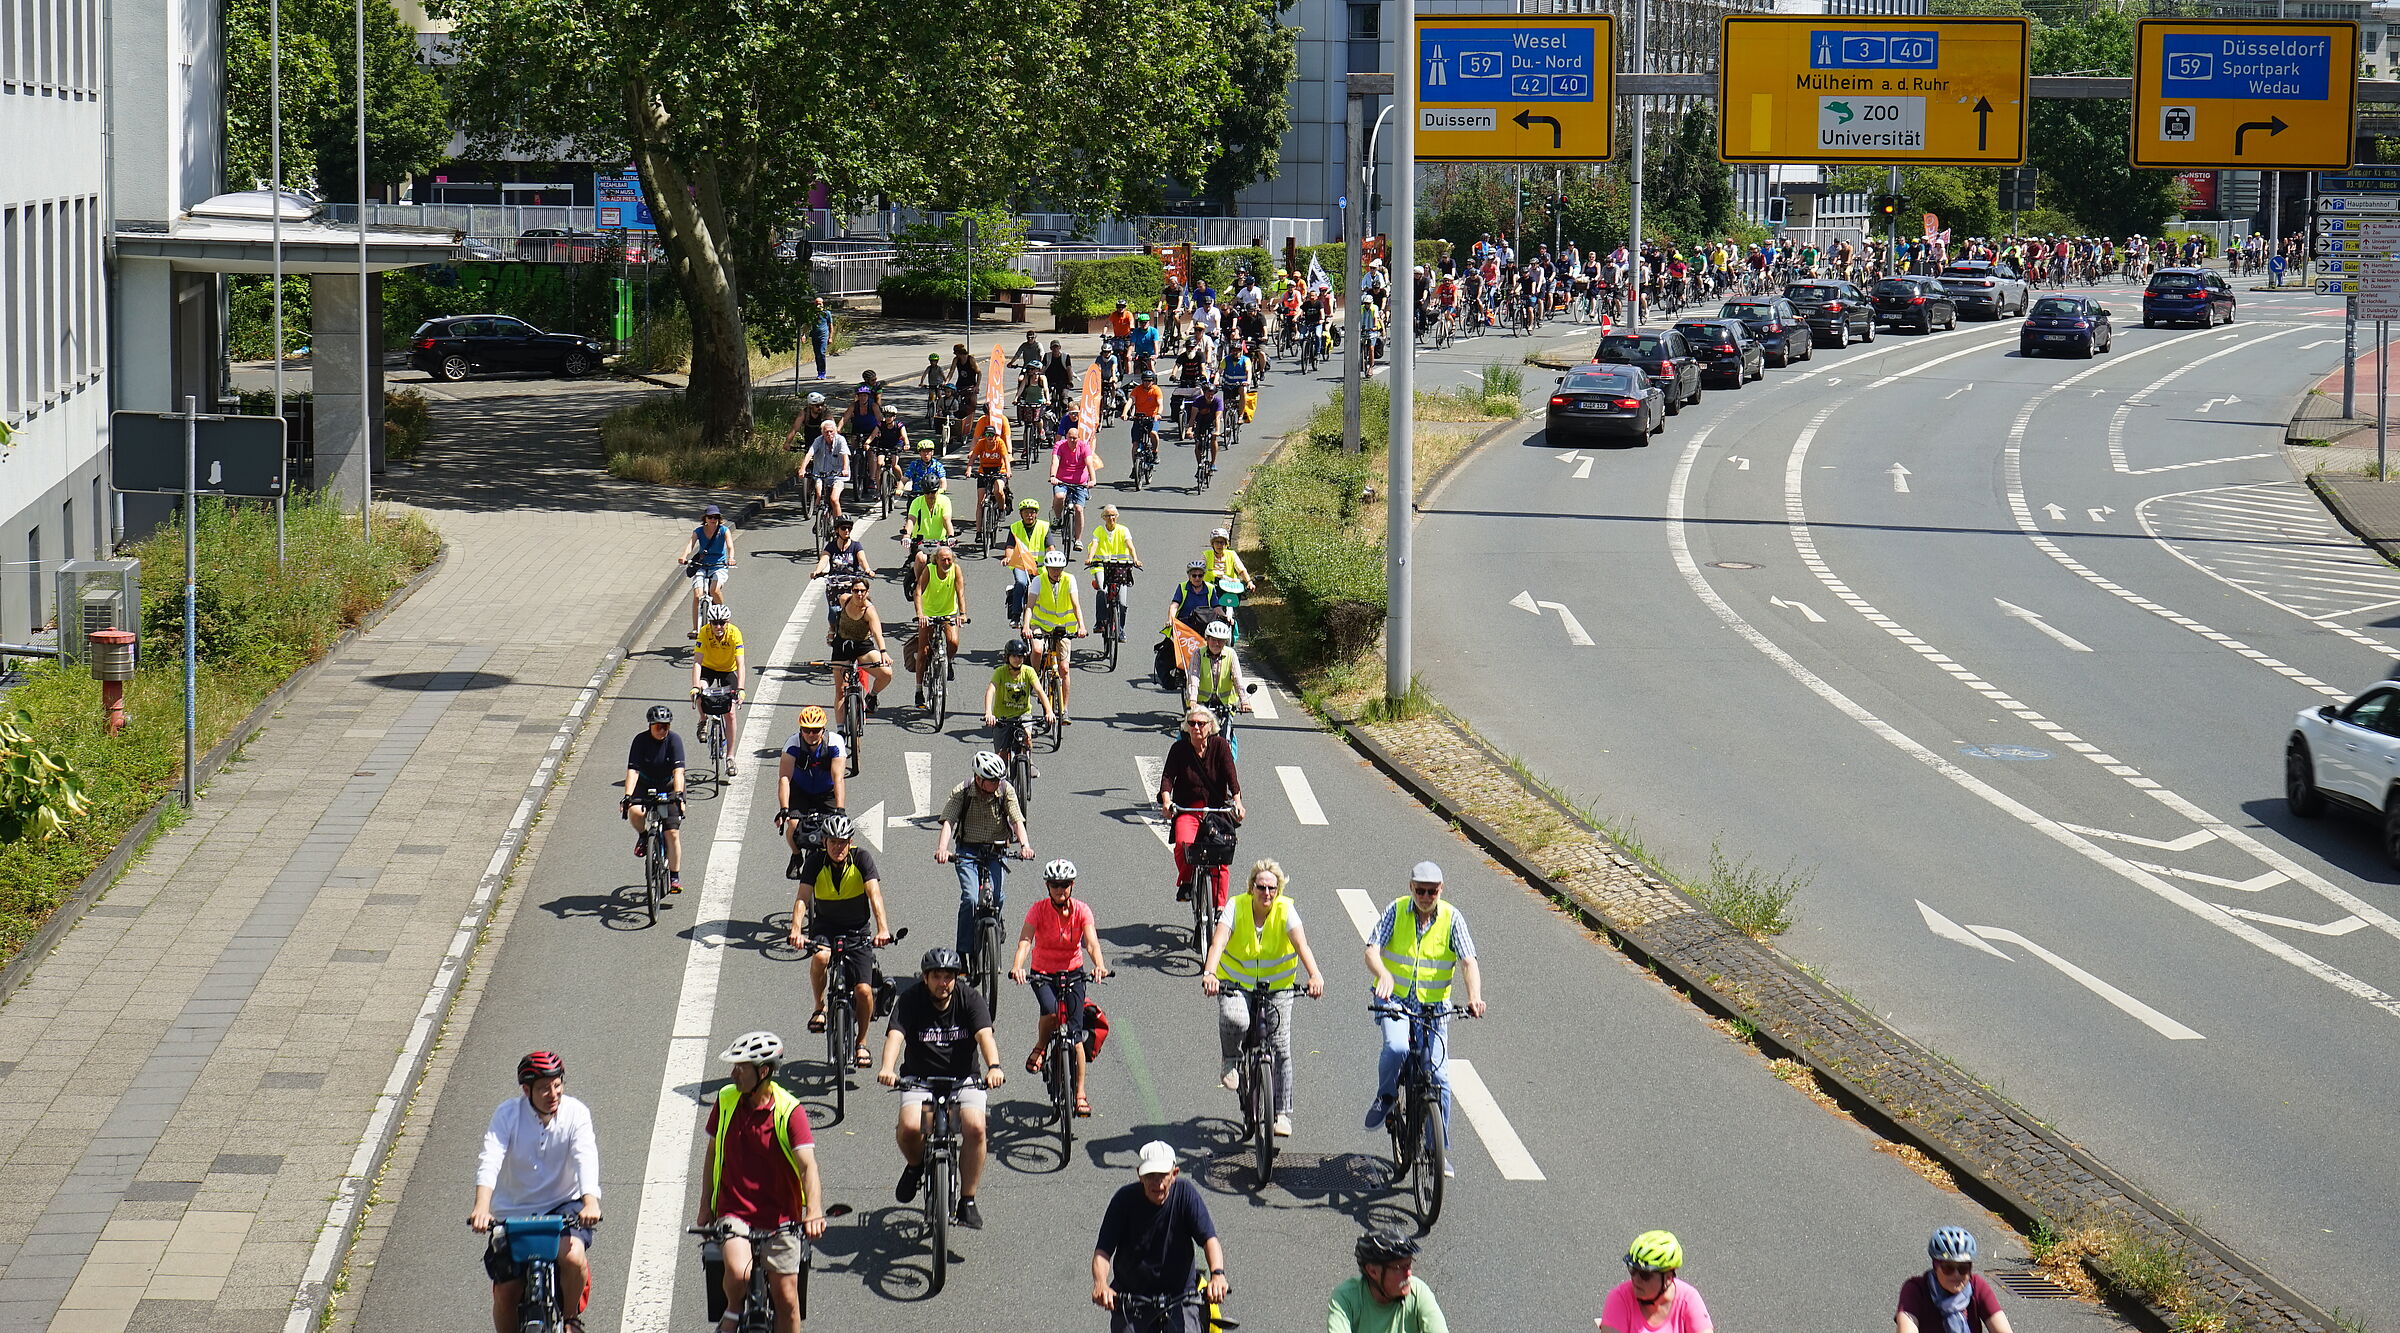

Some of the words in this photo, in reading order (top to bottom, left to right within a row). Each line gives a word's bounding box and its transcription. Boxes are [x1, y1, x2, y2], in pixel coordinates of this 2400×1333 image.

[1512, 33, 1567, 49] Wesel
[2223, 39, 2325, 57] Düsseldorf
[1859, 42, 1870, 58] 3
[1900, 42, 1923, 58] 40
[1470, 57, 1492, 73] 59
[1545, 55, 1582, 69] Nord
[2180, 58, 2201, 75] 59
[2222, 61, 2300, 78] Sportpark
[1520, 79, 1540, 92] 42
[1559, 79, 1578, 92] 40
[1796, 74, 1873, 90] Mülheim
[1881, 80, 1893, 91] a.
[1897, 77, 1909, 91] d.
[1913, 77, 1950, 91] Ruhr
[2249, 80, 2300, 94] Wedau
[1425, 113, 1491, 127] Duissern
[1863, 105, 1899, 121] ZOO
[1822, 129, 1921, 146] Universität
[2347, 200, 2390, 209] Hauptbahnhof
